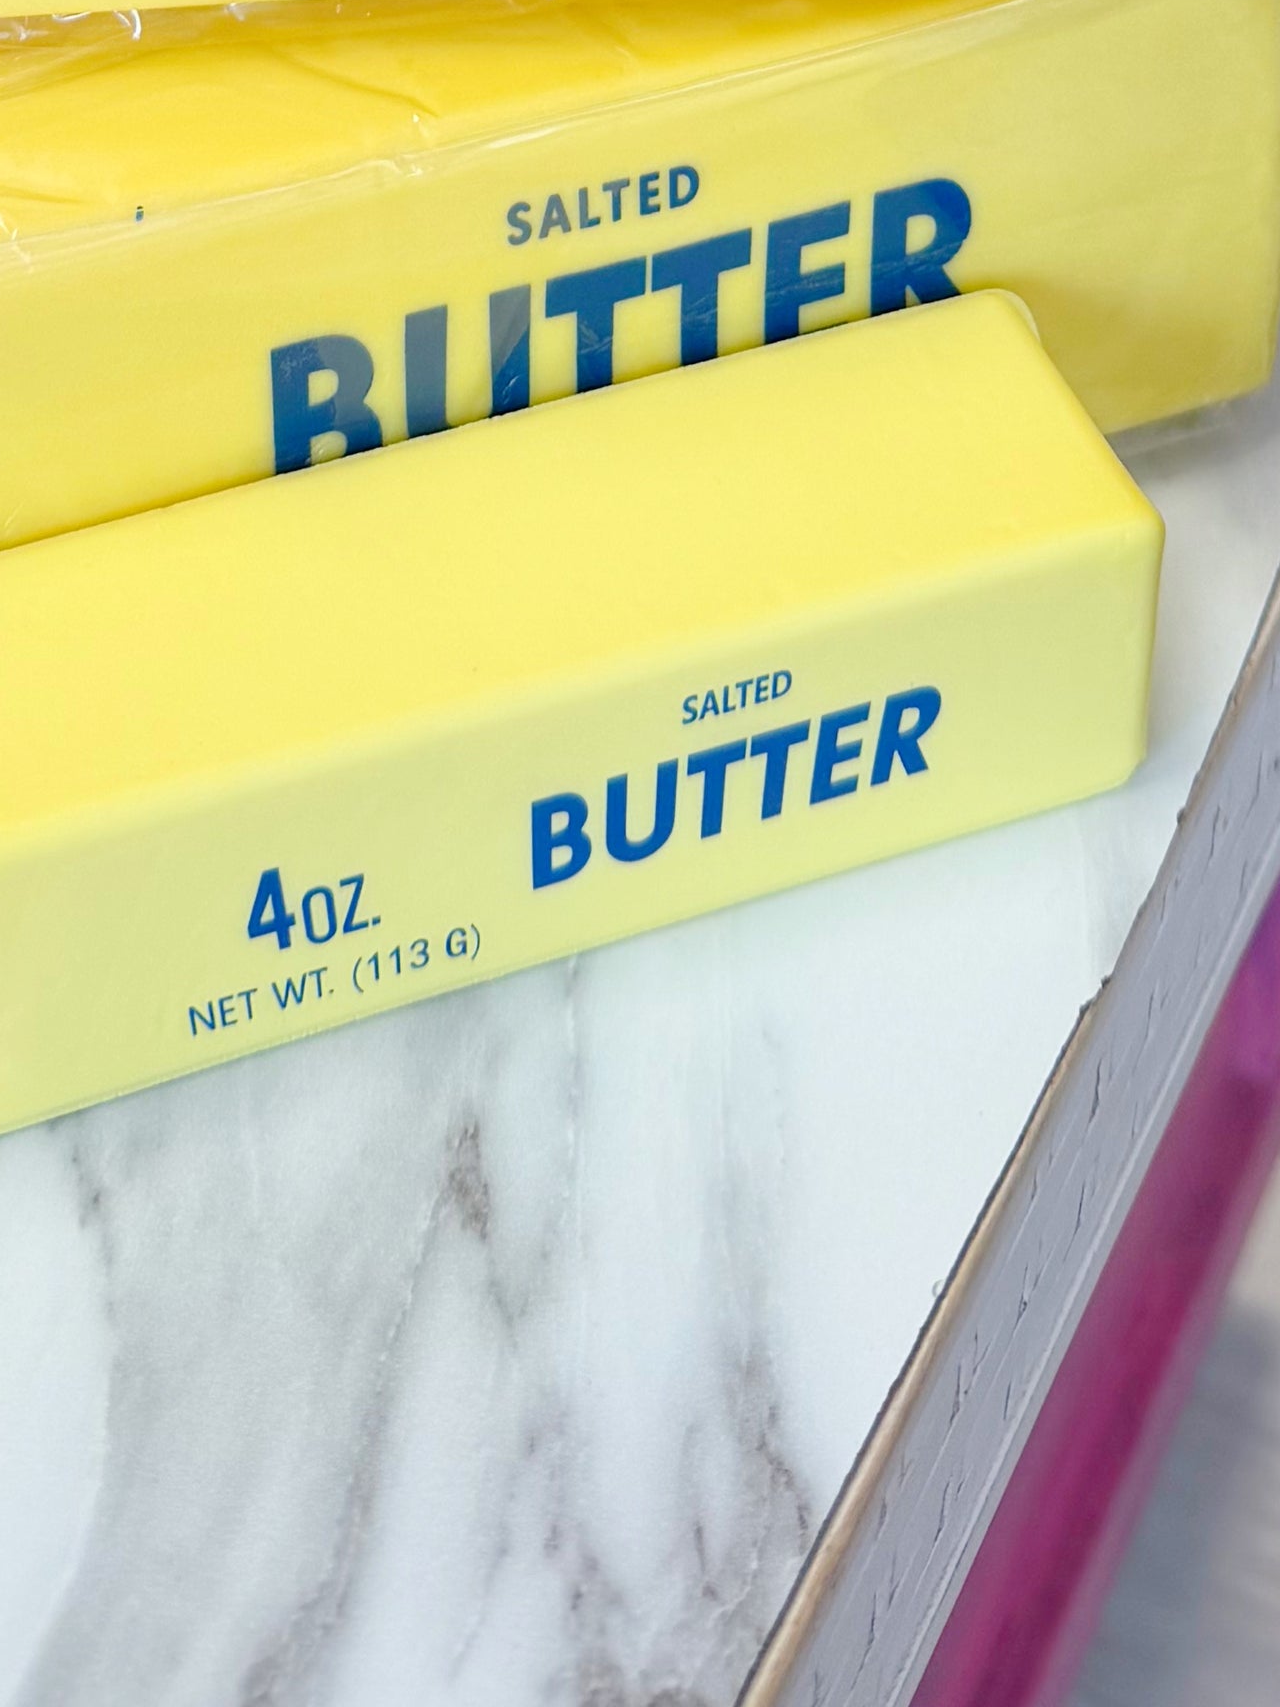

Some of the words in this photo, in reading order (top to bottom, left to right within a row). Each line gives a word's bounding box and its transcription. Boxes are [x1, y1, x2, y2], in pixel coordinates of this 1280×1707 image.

[506, 164, 702, 247] SALTED
[269, 177, 973, 477] BUTTER
[681, 668, 795, 726] SALTED
[529, 684, 944, 891] BUTTER
[187, 987, 258, 1037] NET
[271, 966, 337, 1012] WT.
[350, 937, 431, 995] (113
[444, 922, 484, 962] G)
